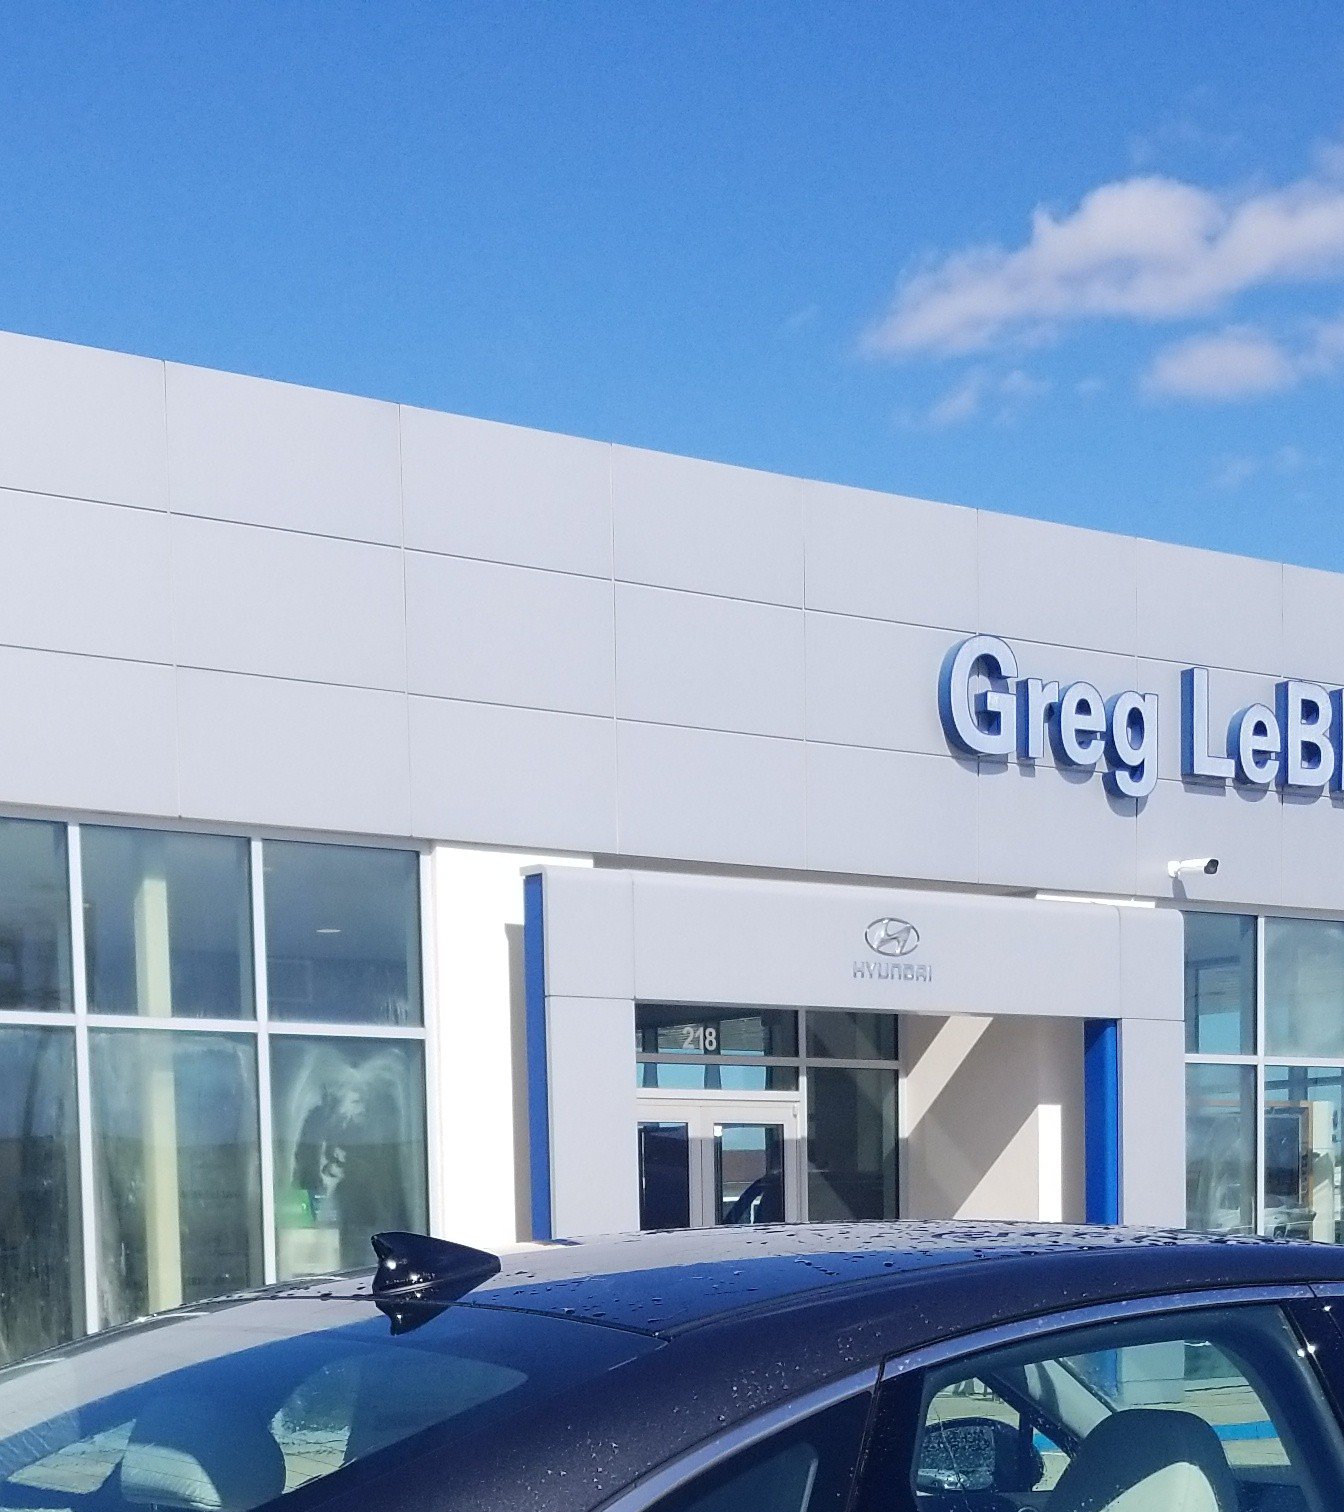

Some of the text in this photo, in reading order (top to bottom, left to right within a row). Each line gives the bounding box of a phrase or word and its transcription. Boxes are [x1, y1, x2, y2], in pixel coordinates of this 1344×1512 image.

[938, 634, 1159, 797] Greg
[852, 960, 932, 981] HYUNDAI
[682, 1026, 717, 1051] 218
